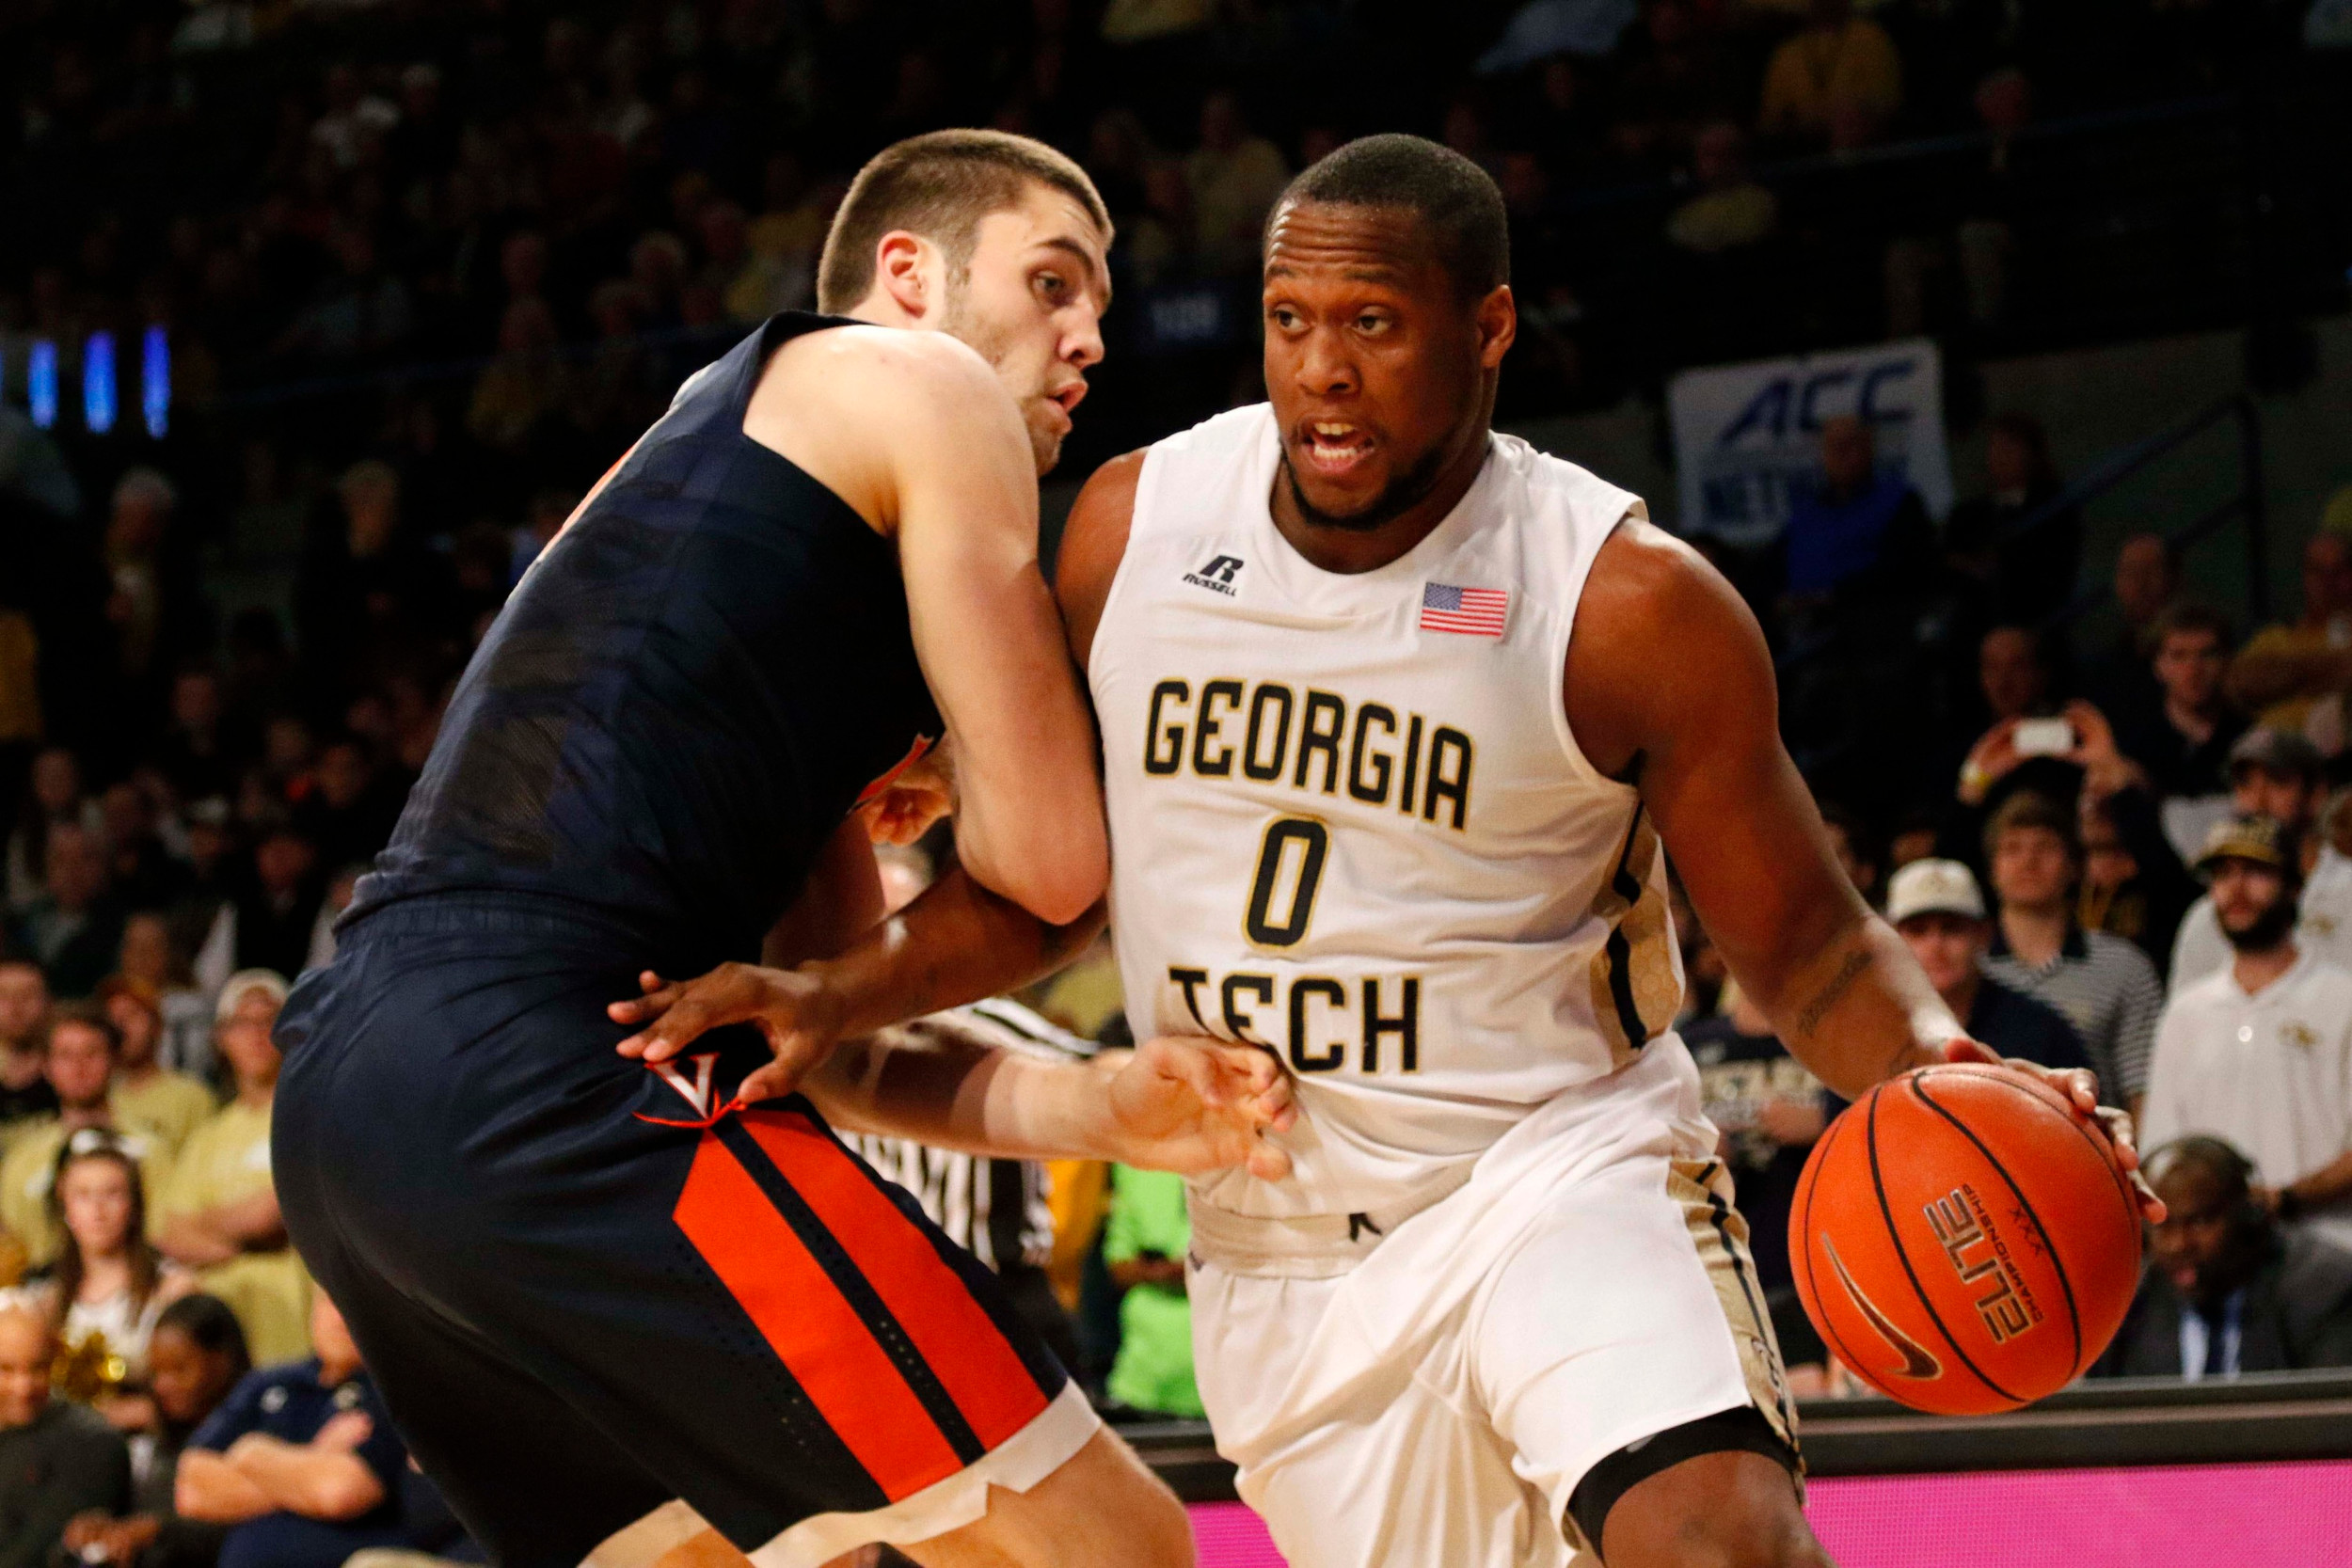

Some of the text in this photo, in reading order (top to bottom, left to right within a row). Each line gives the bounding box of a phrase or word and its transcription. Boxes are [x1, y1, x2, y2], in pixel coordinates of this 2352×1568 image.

[1717, 359, 1915, 446] ACC
[1183, 573, 1237, 596] RUSSELL
[1144, 676, 1477, 832] GEORGIA
[1242, 813, 1331, 951] 0
[1168, 964, 1423, 1076] TECH
[1923, 1188, 2032, 1345] ELITE
[1962, 1182, 2044, 1323] CHAMPIONSHIP
